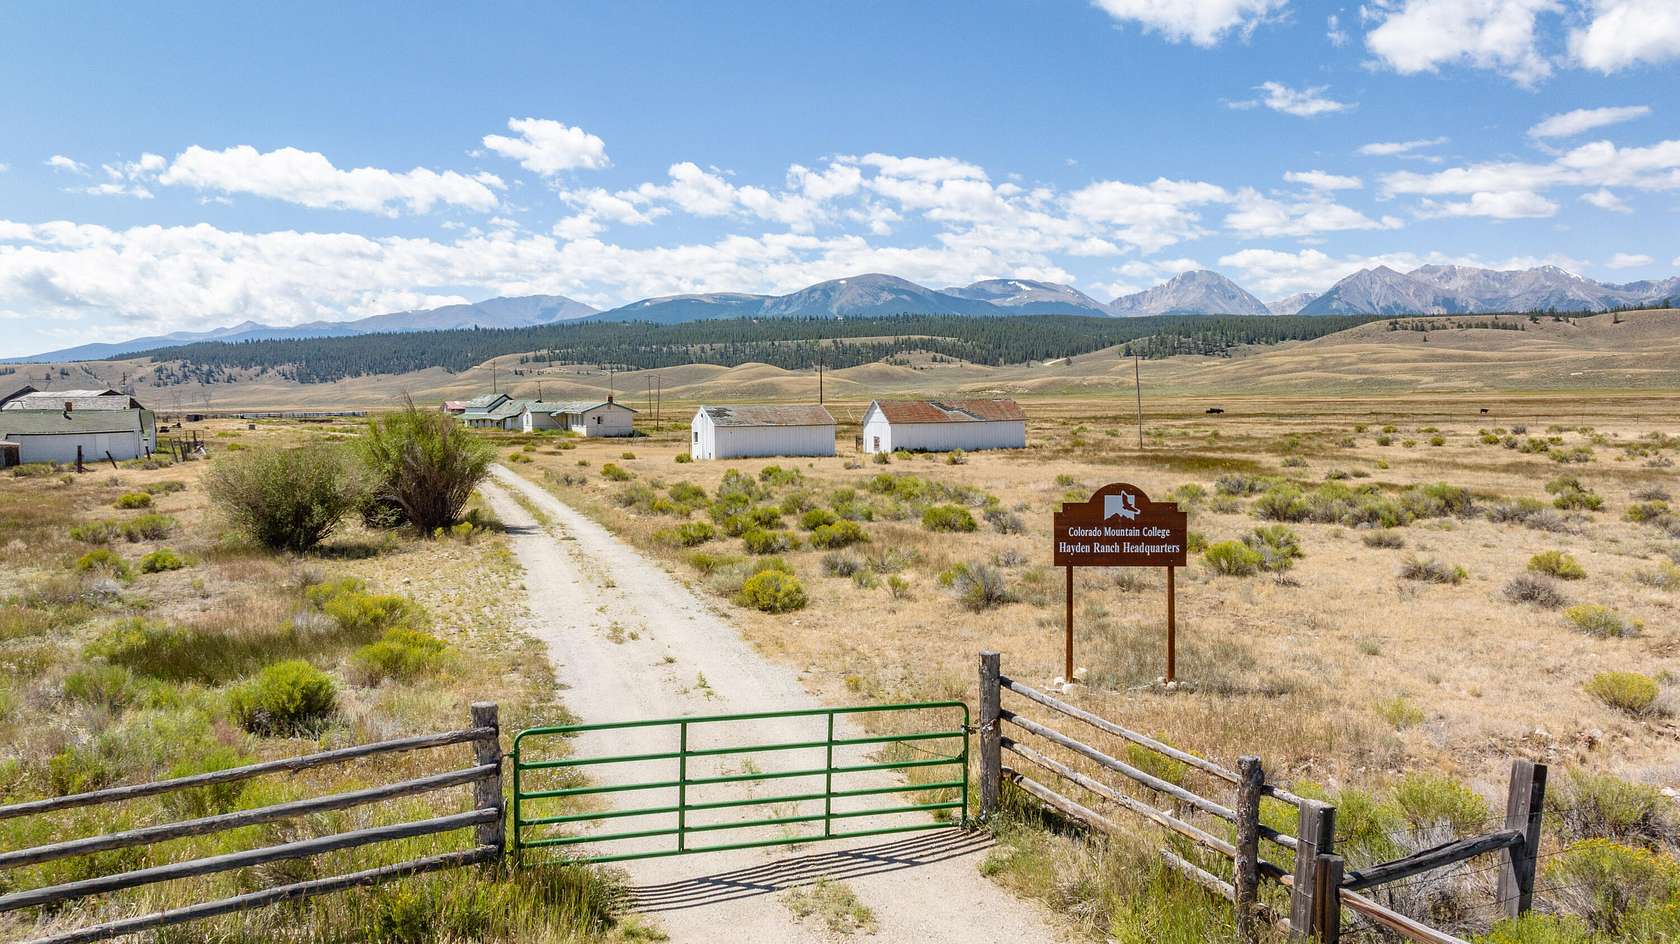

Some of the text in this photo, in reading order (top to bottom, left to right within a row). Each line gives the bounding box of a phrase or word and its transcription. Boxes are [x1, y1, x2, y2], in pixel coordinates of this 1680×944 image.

[1068, 527, 1170, 538] Colorado Mountain College
[1059, 541, 1180, 555] Hayden Ranch Headquarters
